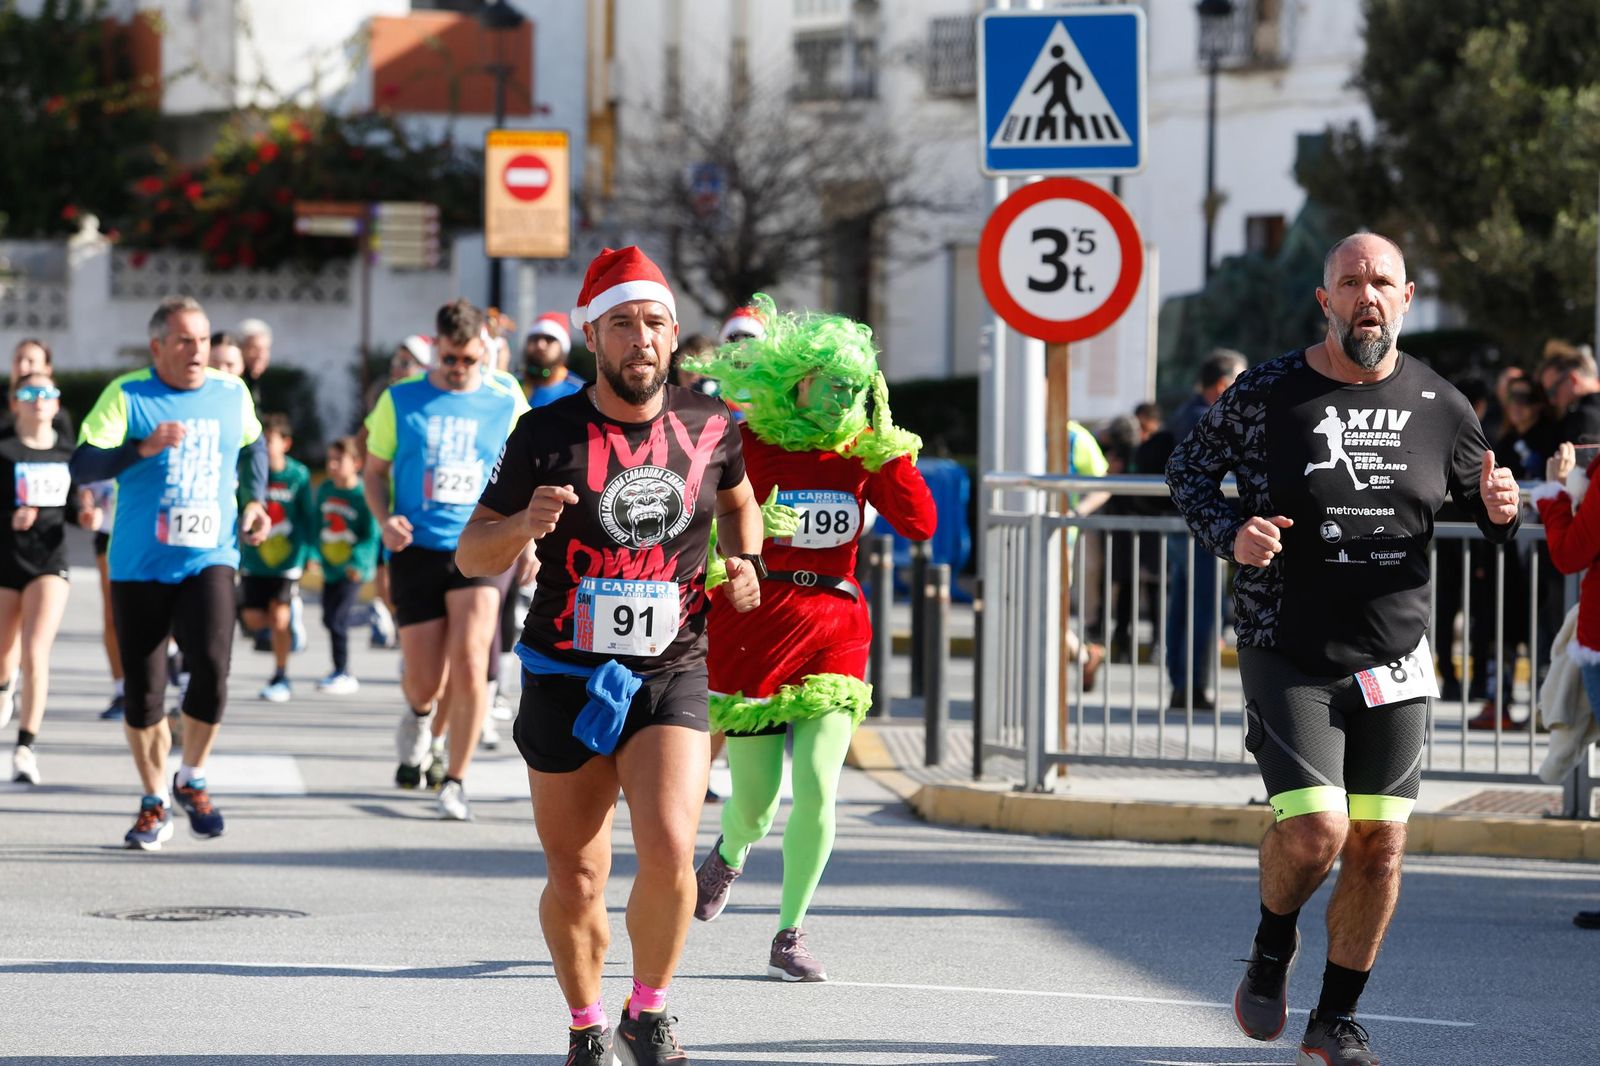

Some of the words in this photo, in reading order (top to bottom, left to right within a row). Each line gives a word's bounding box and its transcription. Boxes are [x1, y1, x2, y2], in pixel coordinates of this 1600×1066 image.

[1347, 409, 1412, 431] XIV
[1343, 431, 1397, 440] CARRERA
[1343, 438, 1402, 448] ESTRECHO
[586, 411, 728, 514] MY
[1354, 456, 1383, 464] PEPE
[1354, 463, 1408, 471] SERRANO
[436, 471, 473, 492] 225
[624, 467, 664, 483] CARADURA
[1369, 475, 1379, 485] 8
[780, 492, 793, 500] III
[1326, 505, 1396, 516] metrovacesa
[174, 514, 213, 534] 120
[799, 509, 849, 535] 198
[1370, 551, 1407, 562] Cruzcampo
[582, 579, 596, 590] III
[577, 592, 592, 605] SAN
[576, 604, 591, 620] SIL
[576, 618, 593, 633] VES
[612, 604, 655, 638] 91
[576, 632, 593, 651] TRE
